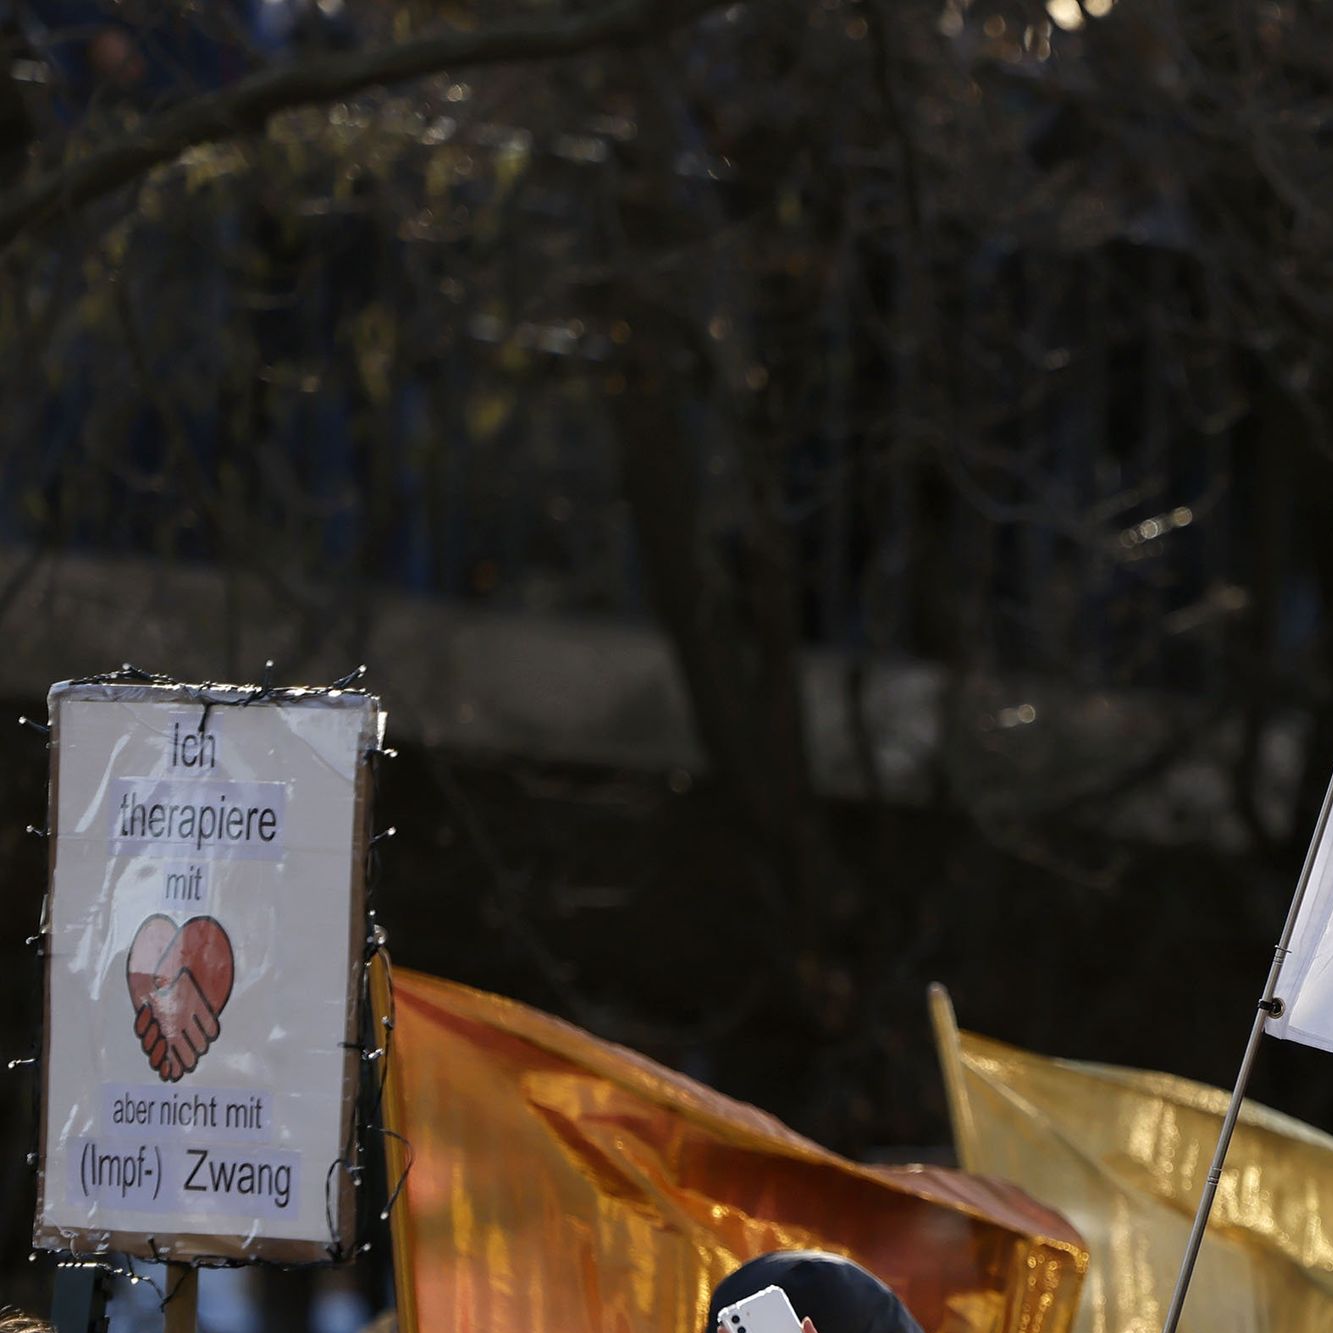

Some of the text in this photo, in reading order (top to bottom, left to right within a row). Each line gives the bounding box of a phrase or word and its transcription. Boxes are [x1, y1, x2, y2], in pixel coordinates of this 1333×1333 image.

[172, 722, 216, 769] Ich
[119, 795, 278, 853] therapiere
[165, 867, 202, 900] mit
[112, 1096, 263, 1130] aber nicht mit
[80, 1144, 292, 1208] (Impf-) Zwang
